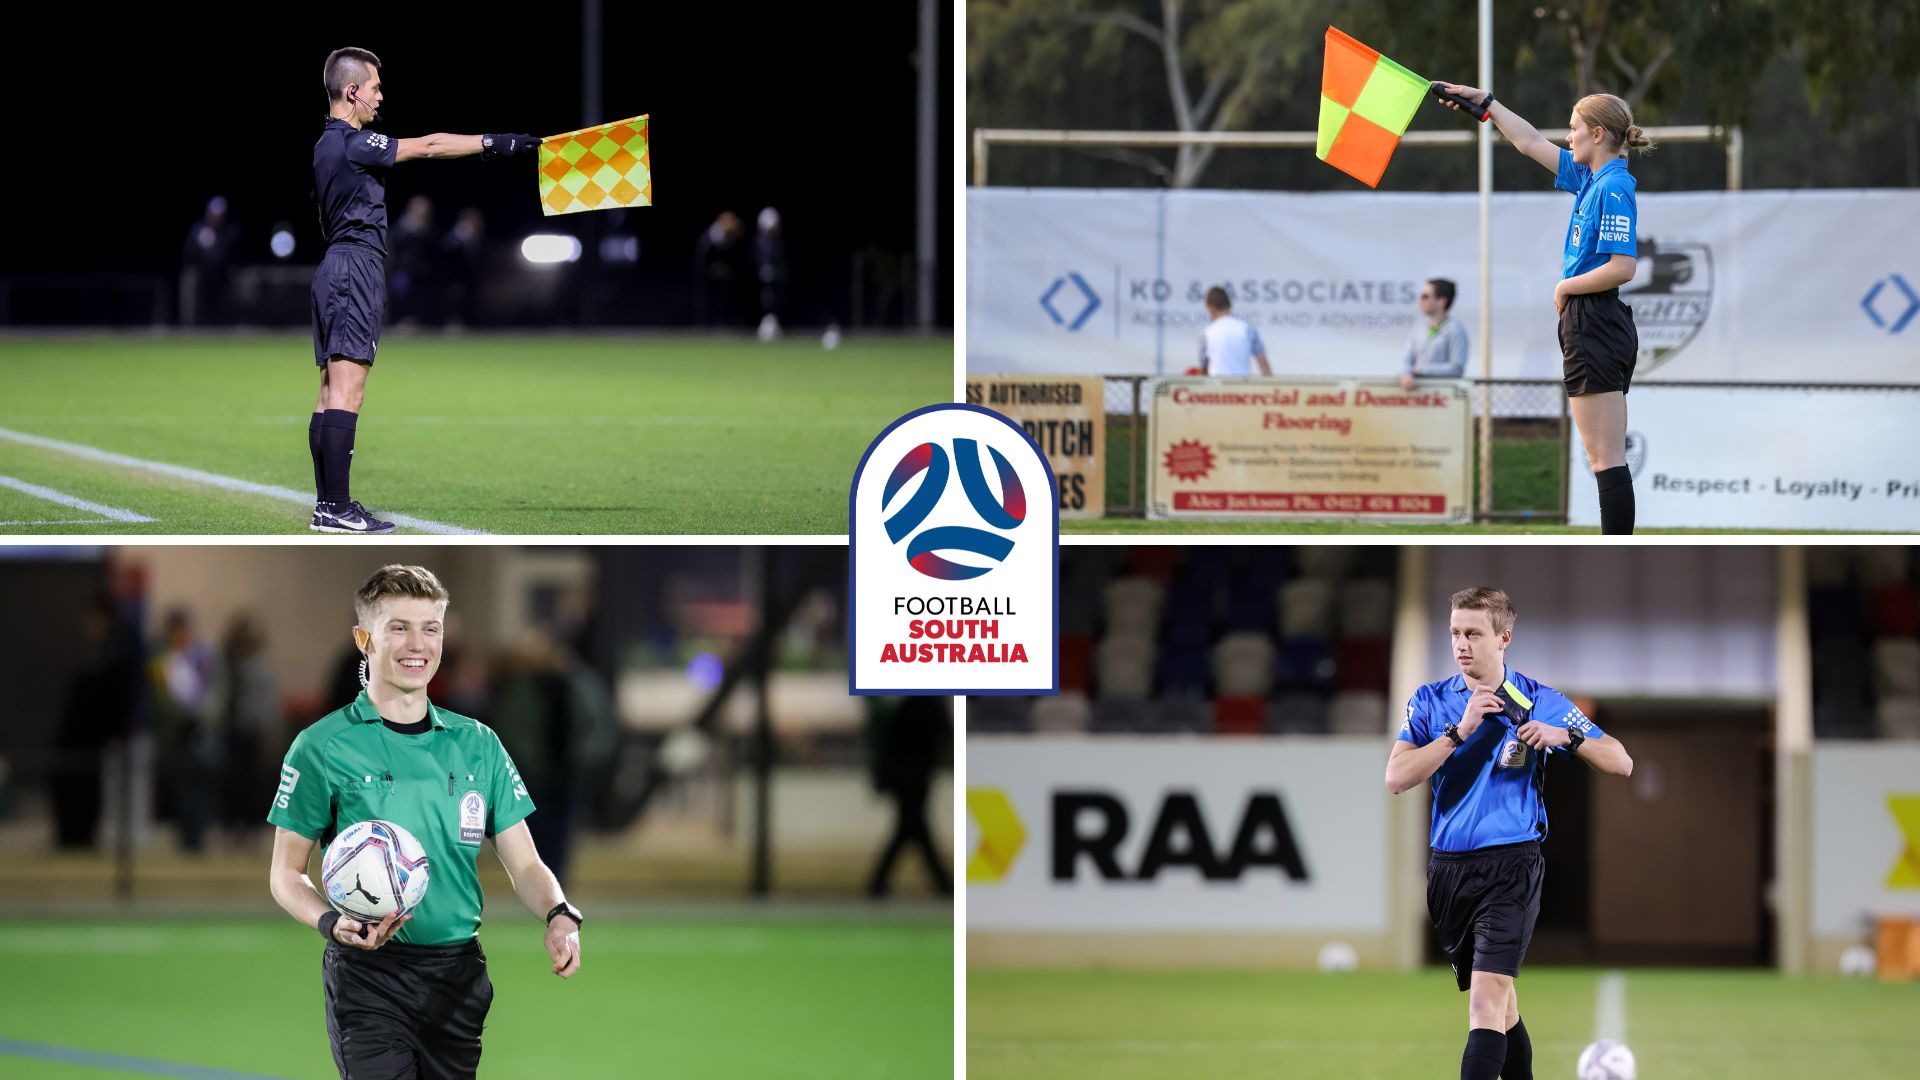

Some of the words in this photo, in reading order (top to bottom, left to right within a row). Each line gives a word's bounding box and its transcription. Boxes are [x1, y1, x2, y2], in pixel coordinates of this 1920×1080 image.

[1599, 232, 1630, 243] NEWS
[1130, 279, 1172, 303] KD
[1222, 279, 1418, 304] ASSOCIATES
[989, 383, 1082, 405] AUTHORISED
[1172, 386, 1300, 406] Commercial
[1305, 389, 1347, 407] and
[1354, 389, 1449, 408] Domestic
[1263, 411, 1352, 437] Flooring
[1652, 474, 1751, 496] Respect
[1774, 477, 1863, 501] Loyalty
[1048, 787, 1311, 884] RAA
